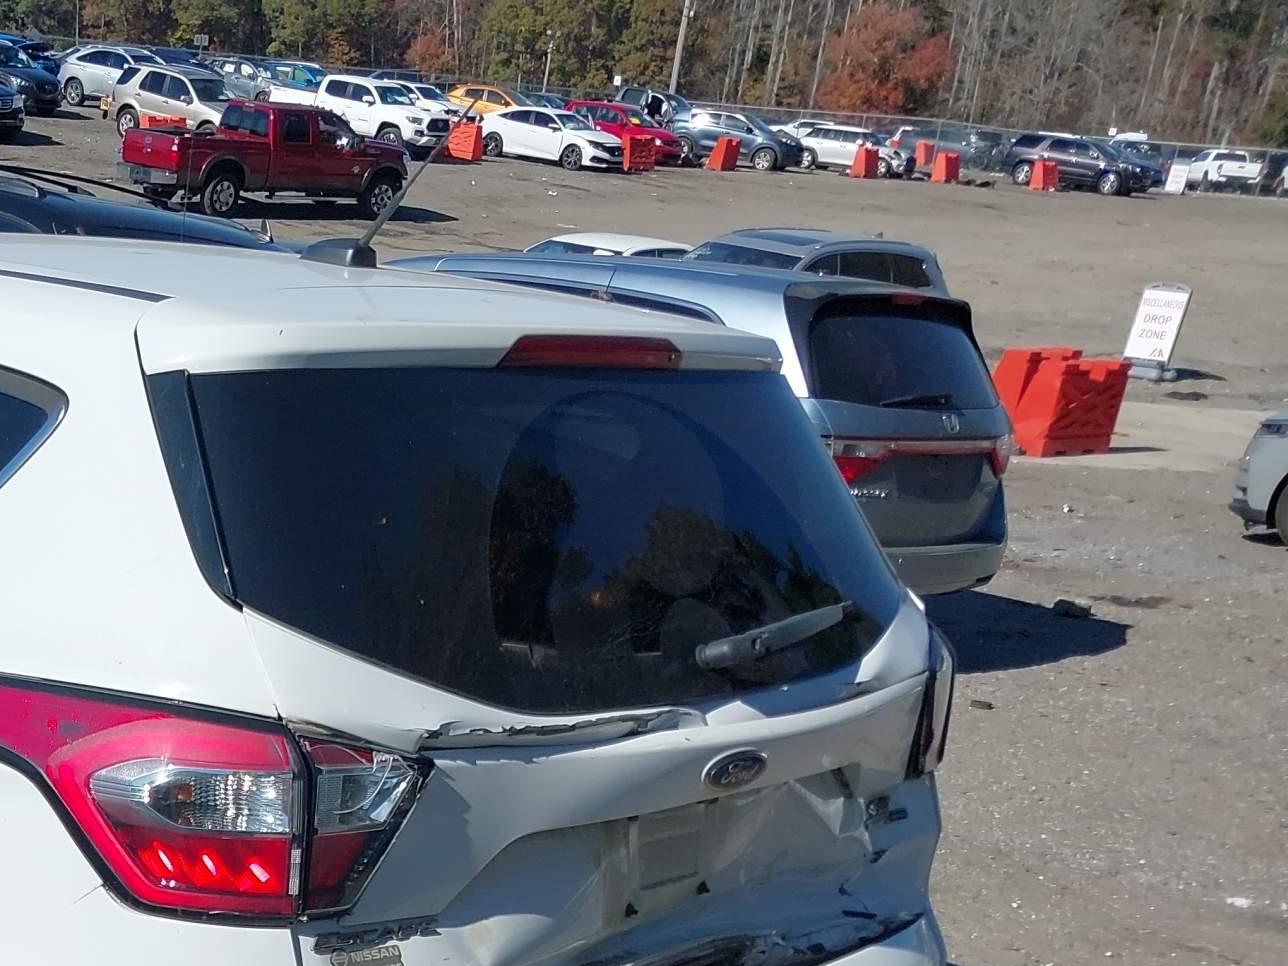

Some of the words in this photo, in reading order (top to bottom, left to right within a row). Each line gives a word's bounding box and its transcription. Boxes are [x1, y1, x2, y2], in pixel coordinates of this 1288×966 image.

[1143, 313, 1173, 326] DROP
[1138, 328, 1167, 340] ZONE
[350, 946, 400, 963] NISSAN
